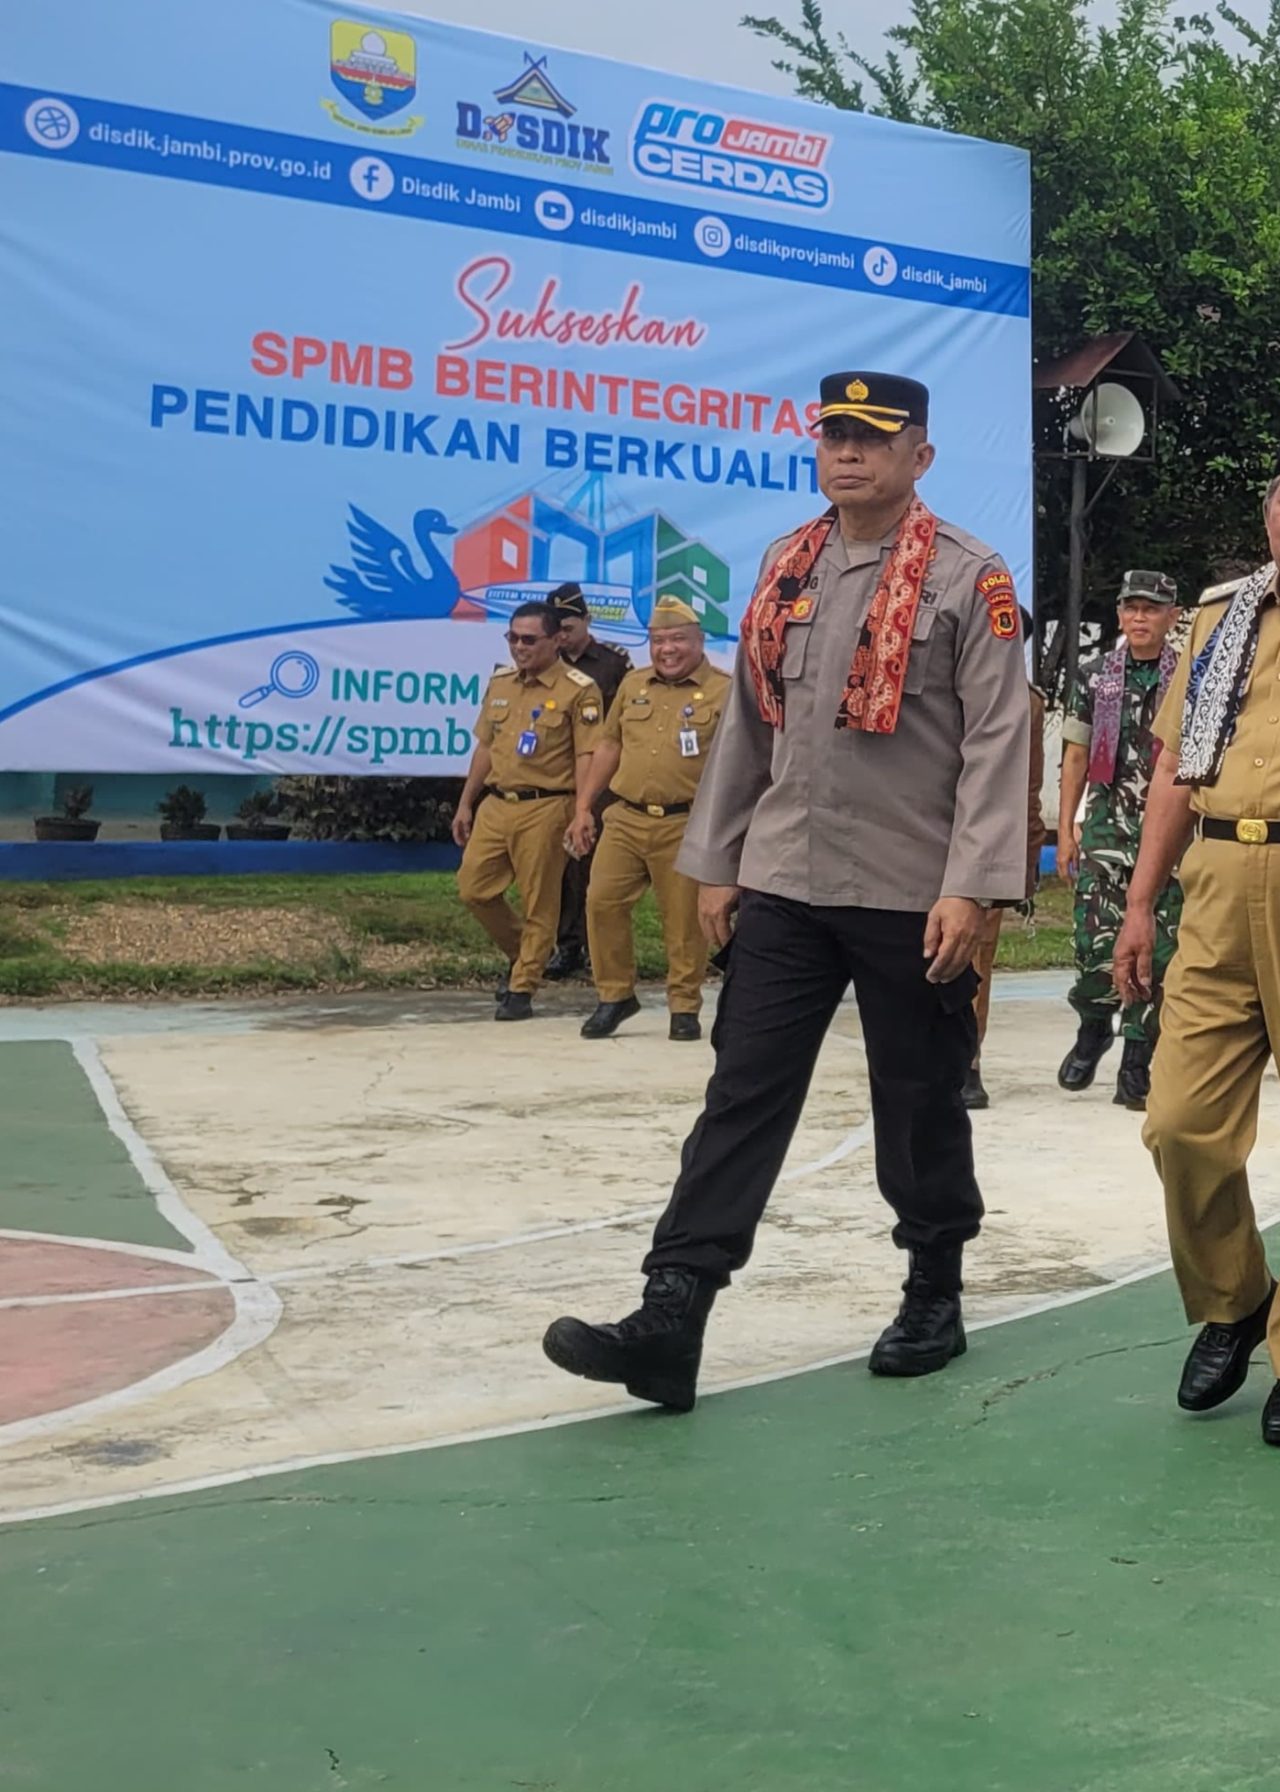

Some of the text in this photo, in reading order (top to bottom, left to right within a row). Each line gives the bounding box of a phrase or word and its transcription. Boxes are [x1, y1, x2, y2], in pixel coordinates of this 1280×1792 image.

[89, 122, 331, 182] disdik.jambi.prov.go.id
[637, 144, 826, 203] CERDAS
[402, 176, 521, 214] Disdik Jambi
[580, 207, 678, 241] disdikjambi
[734, 232, 856, 270] disdikprovjambi
[445, 257, 705, 350] Sukseskan
[902, 264, 988, 293] disdik_jambi
[251, 331, 822, 440] SPMB BERINTEGRITAS
[150, 383, 820, 495] PENDIDIKAN BERKUALIT
[331, 667, 480, 706] INFORM
[168, 707, 473, 764] https://spmb
